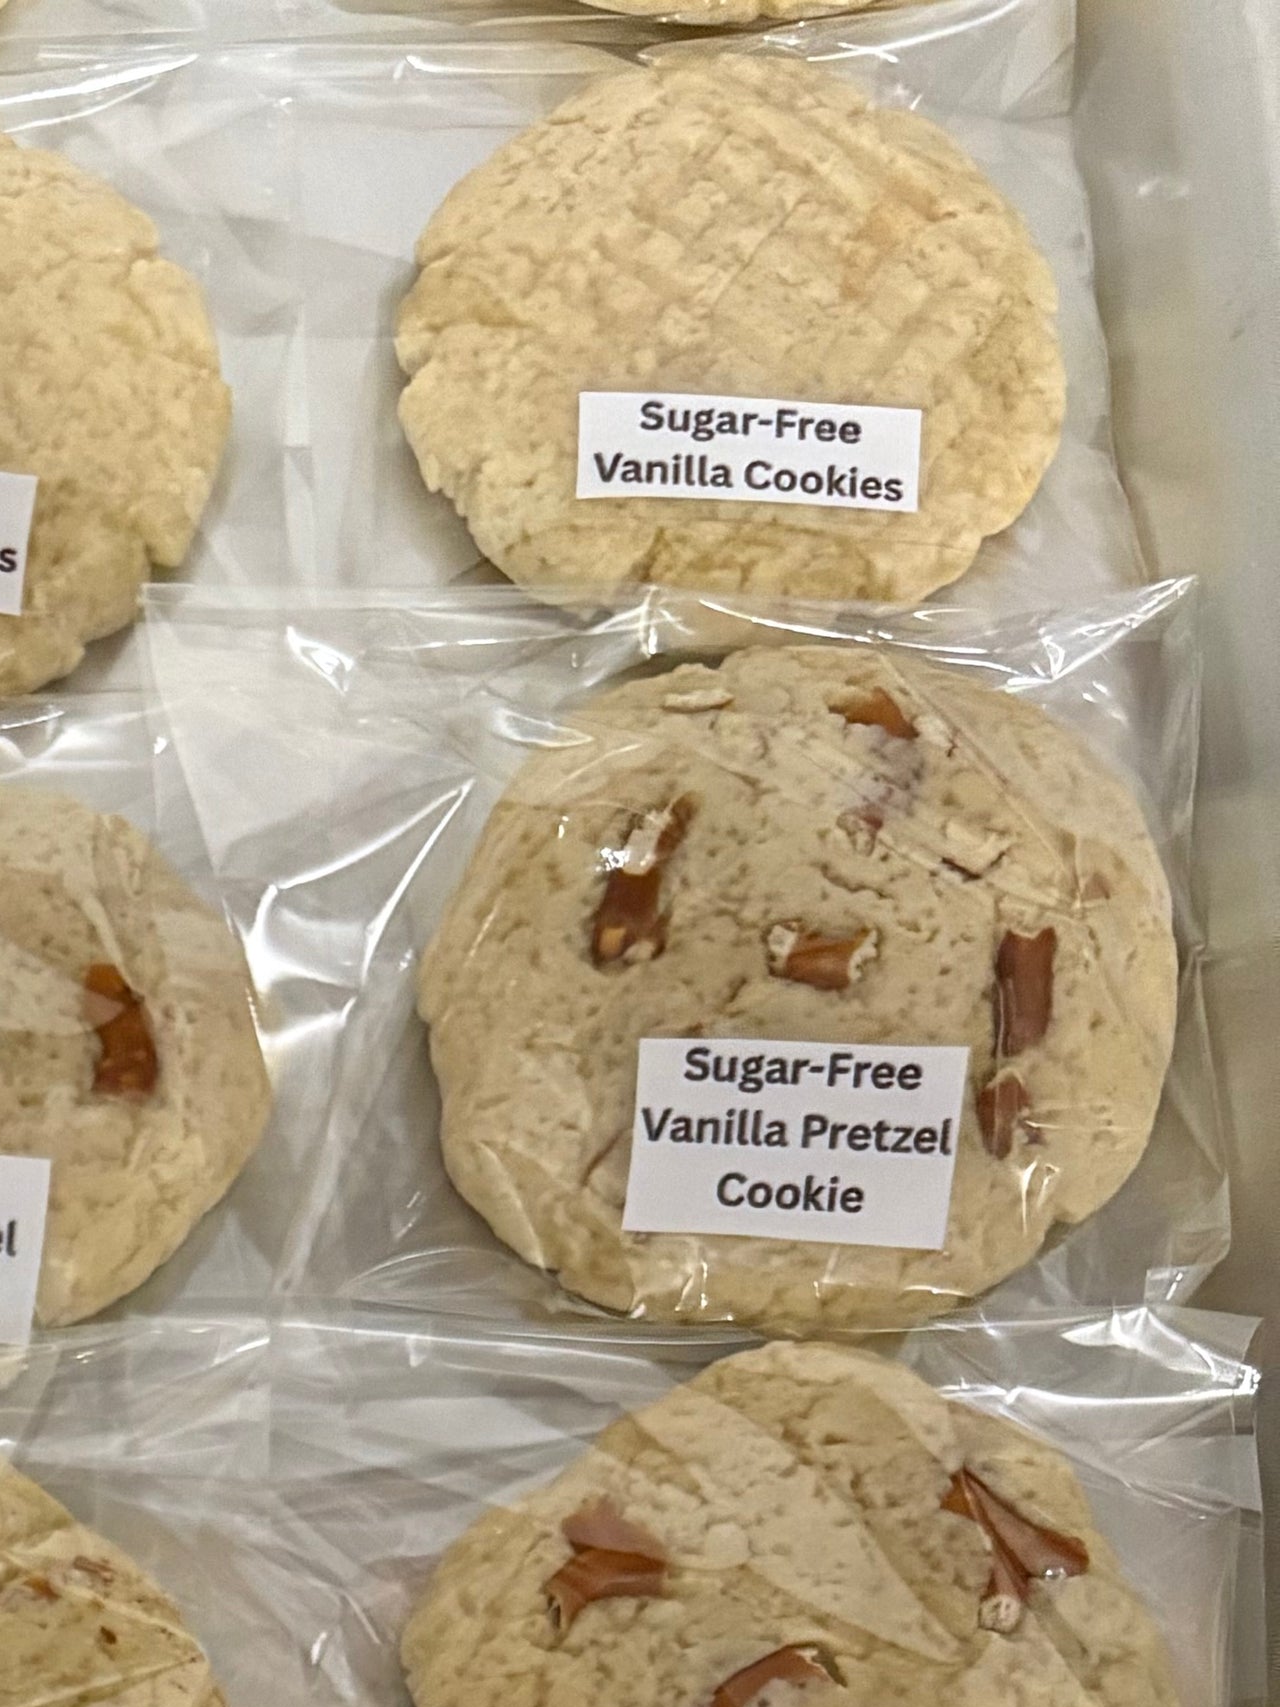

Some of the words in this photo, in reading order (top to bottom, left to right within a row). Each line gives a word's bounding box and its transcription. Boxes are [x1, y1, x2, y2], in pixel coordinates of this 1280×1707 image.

[639, 400, 862, 445] Sugar-Free
[593, 451, 734, 489] Vanilla
[744, 459, 904, 502] Cookies
[683, 1046, 923, 1094] Sugar-Free
[641, 1107, 789, 1148] Vanilla
[800, 1113, 953, 1156] Pretzel
[716, 1171, 865, 1214] Cookie
